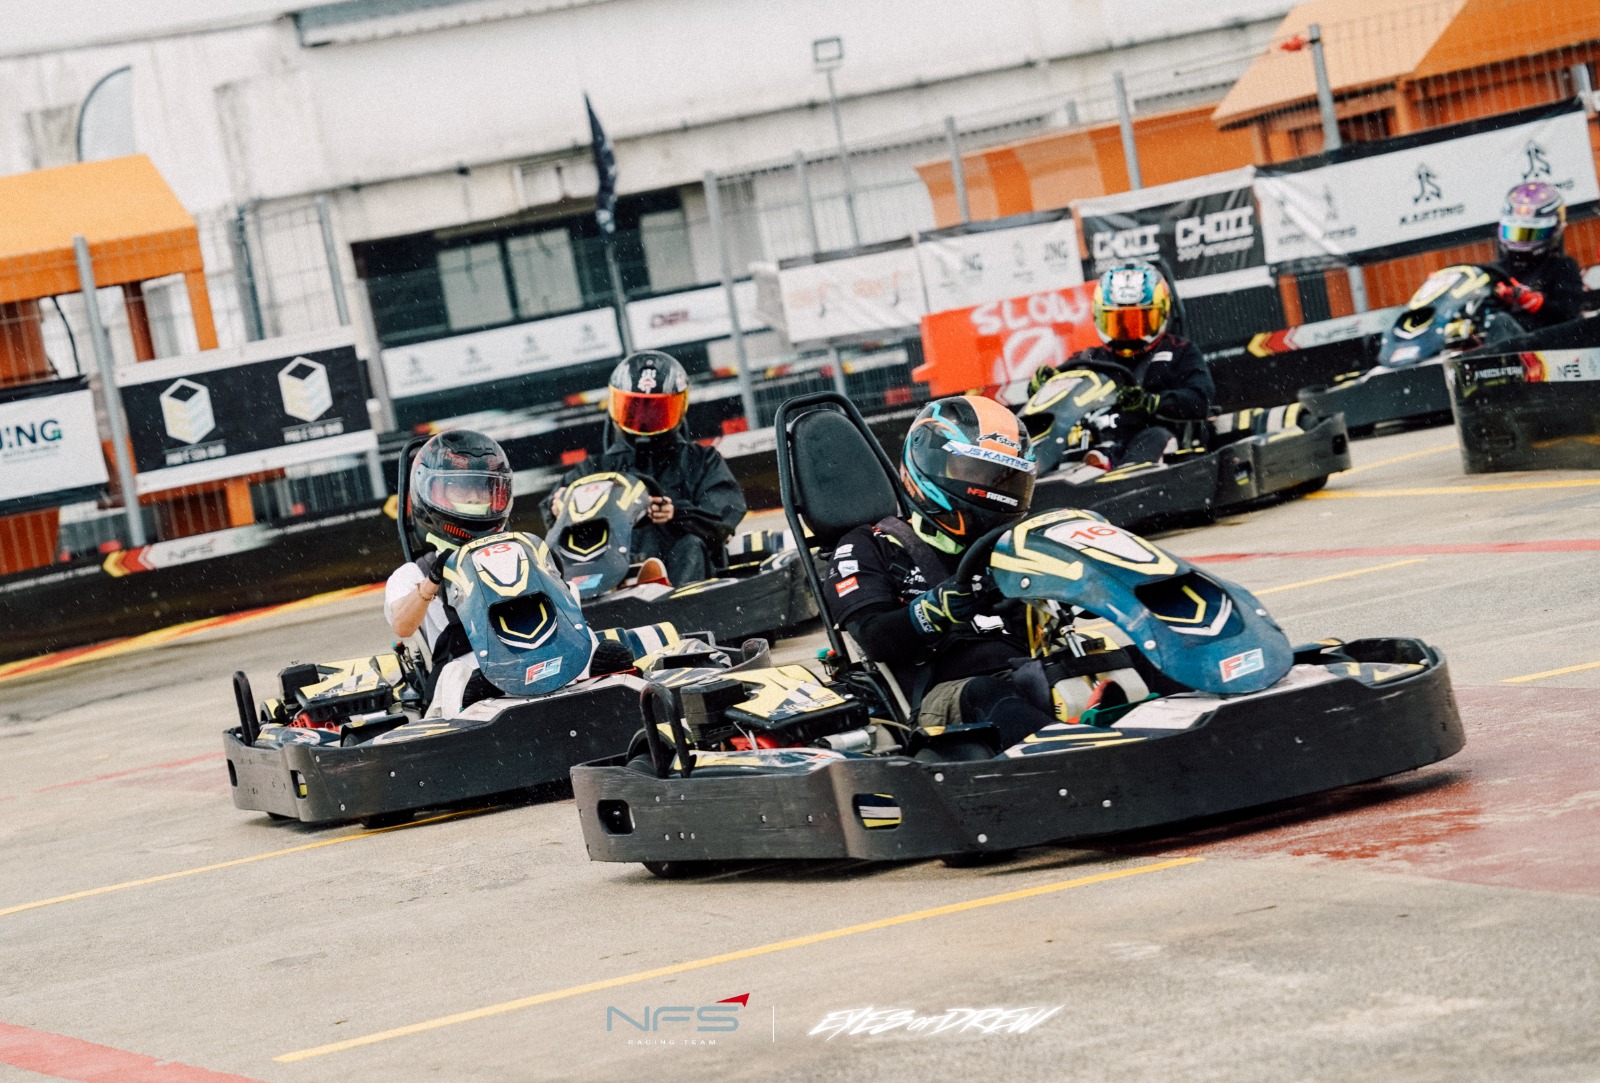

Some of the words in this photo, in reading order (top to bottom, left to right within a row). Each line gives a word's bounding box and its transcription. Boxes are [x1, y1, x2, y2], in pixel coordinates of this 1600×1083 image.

[970, 287, 1089, 336] SLOW
[983, 450, 1029, 470] KARTING
[967, 487, 987, 498] NFS
[1070, 525, 1118, 541] 16
[476, 543, 512, 557] 13
